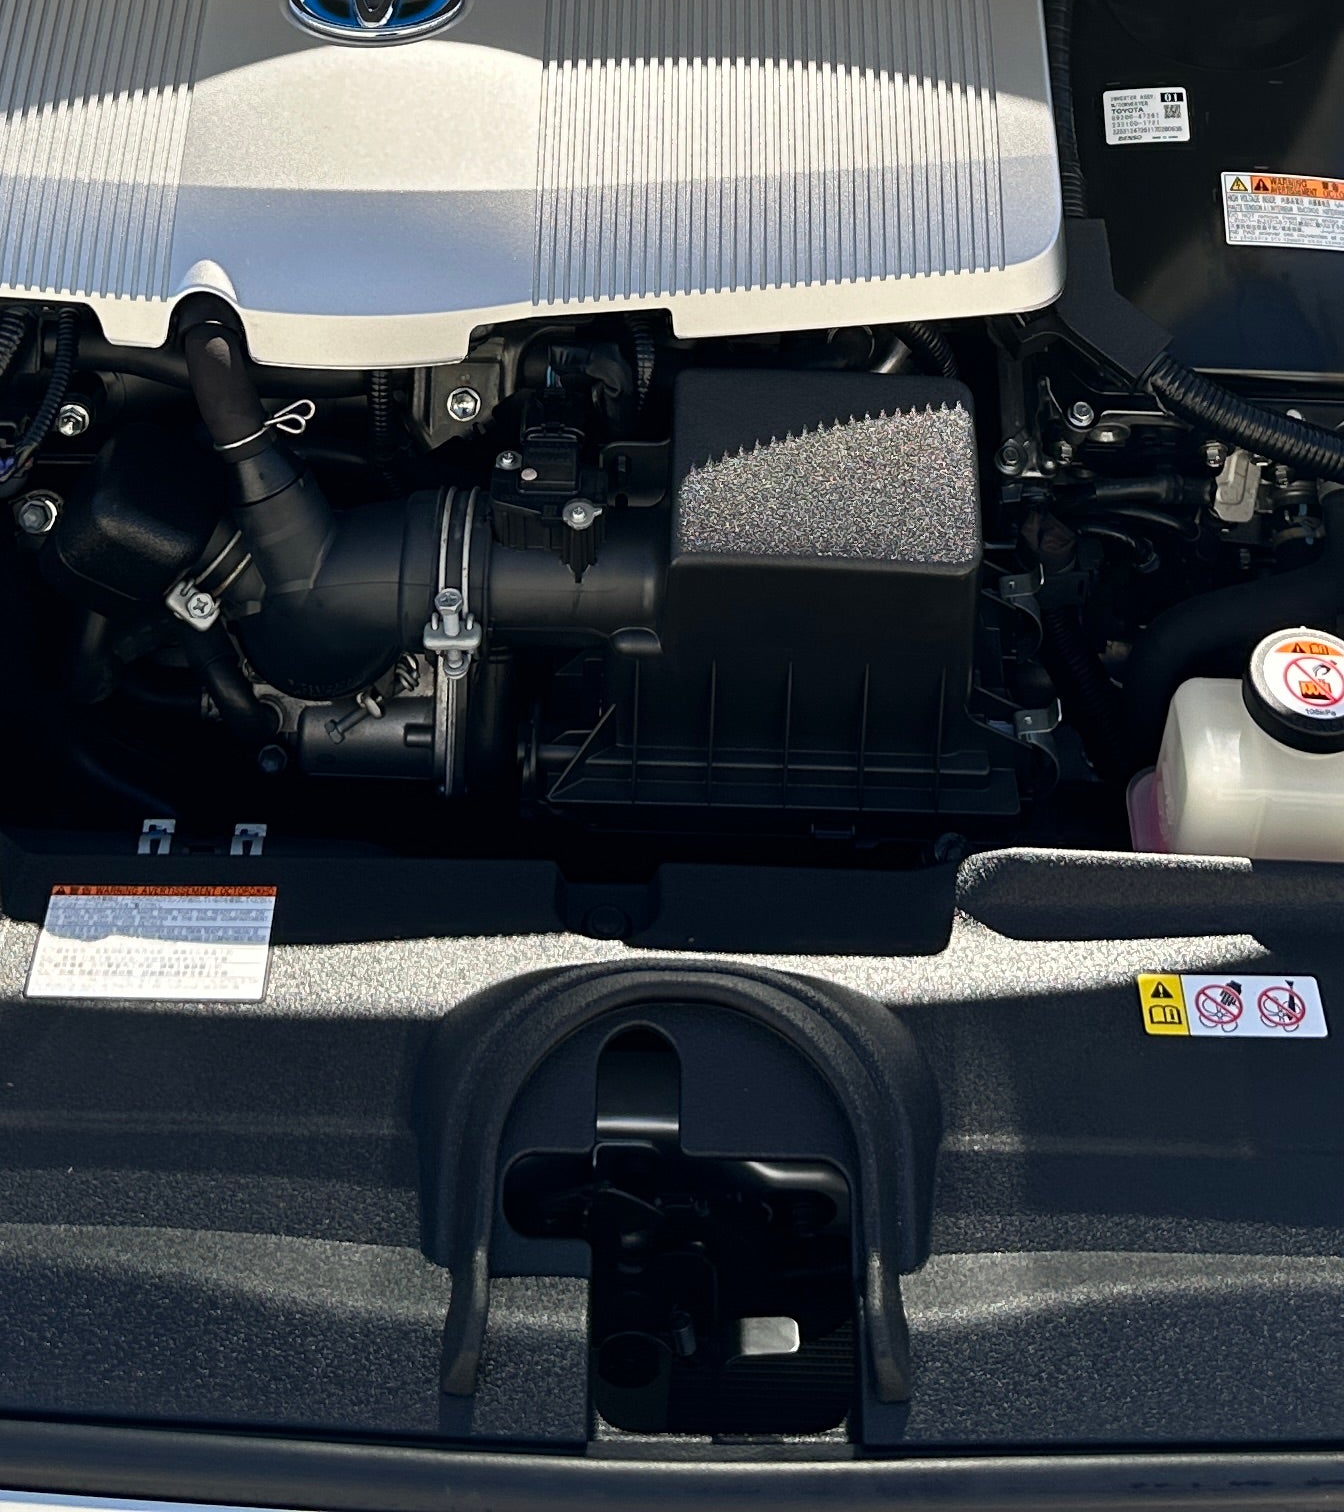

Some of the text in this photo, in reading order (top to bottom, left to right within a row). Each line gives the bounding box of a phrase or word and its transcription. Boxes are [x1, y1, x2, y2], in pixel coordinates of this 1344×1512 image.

[1164, 93, 1178, 102] 01
[1111, 107, 1144, 115] TOYOTA
[1270, 176, 1308, 188] WARNING
